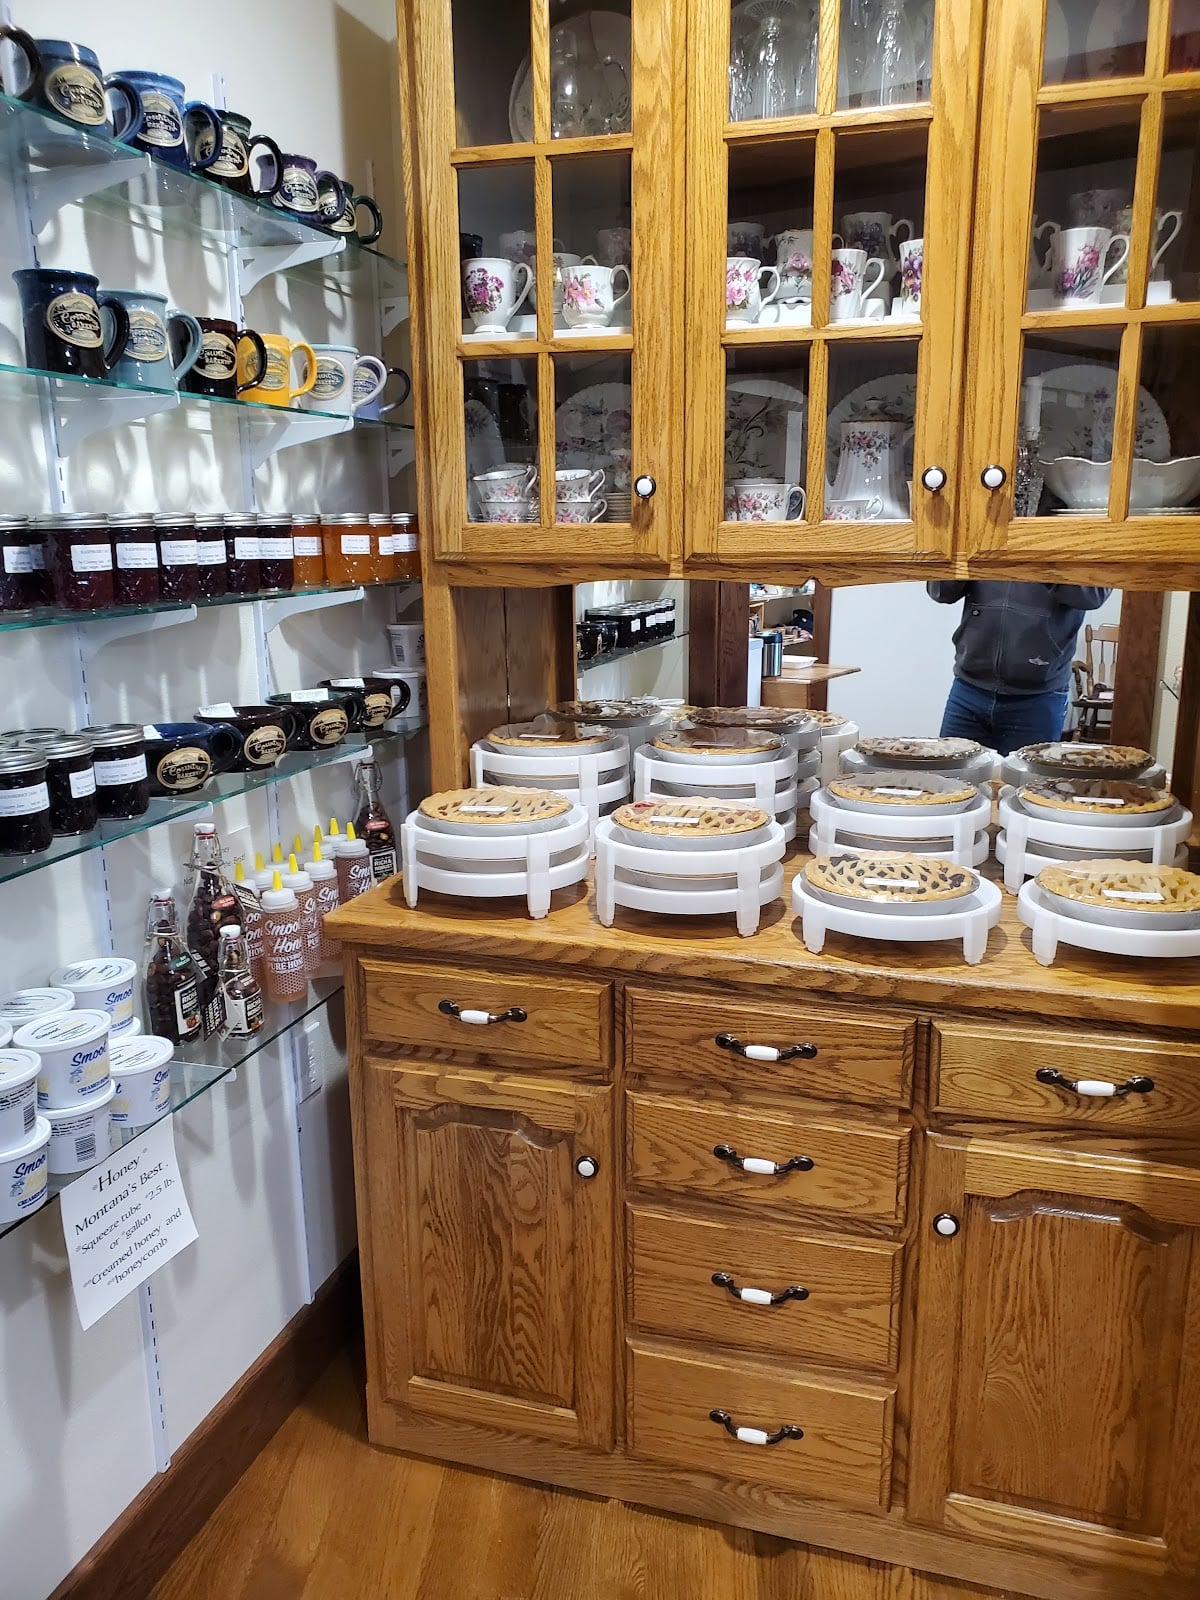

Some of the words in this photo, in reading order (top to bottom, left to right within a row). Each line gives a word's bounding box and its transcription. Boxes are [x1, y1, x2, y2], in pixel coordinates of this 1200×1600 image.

[98, 1156, 140, 1193] Honey
[75, 1182, 137, 1236] Montana's
[81, 1220, 121, 1255] Squeeze
[121, 1202, 142, 1222] tube
[109, 1238, 120, 1250] or
[125, 1212, 152, 1239] gallon
[91, 1247, 133, 1285] Creamed
[133, 1225, 161, 1251] honey
[165, 1207, 183, 1226] and
[114, 1237, 168, 1284] honeycomb
